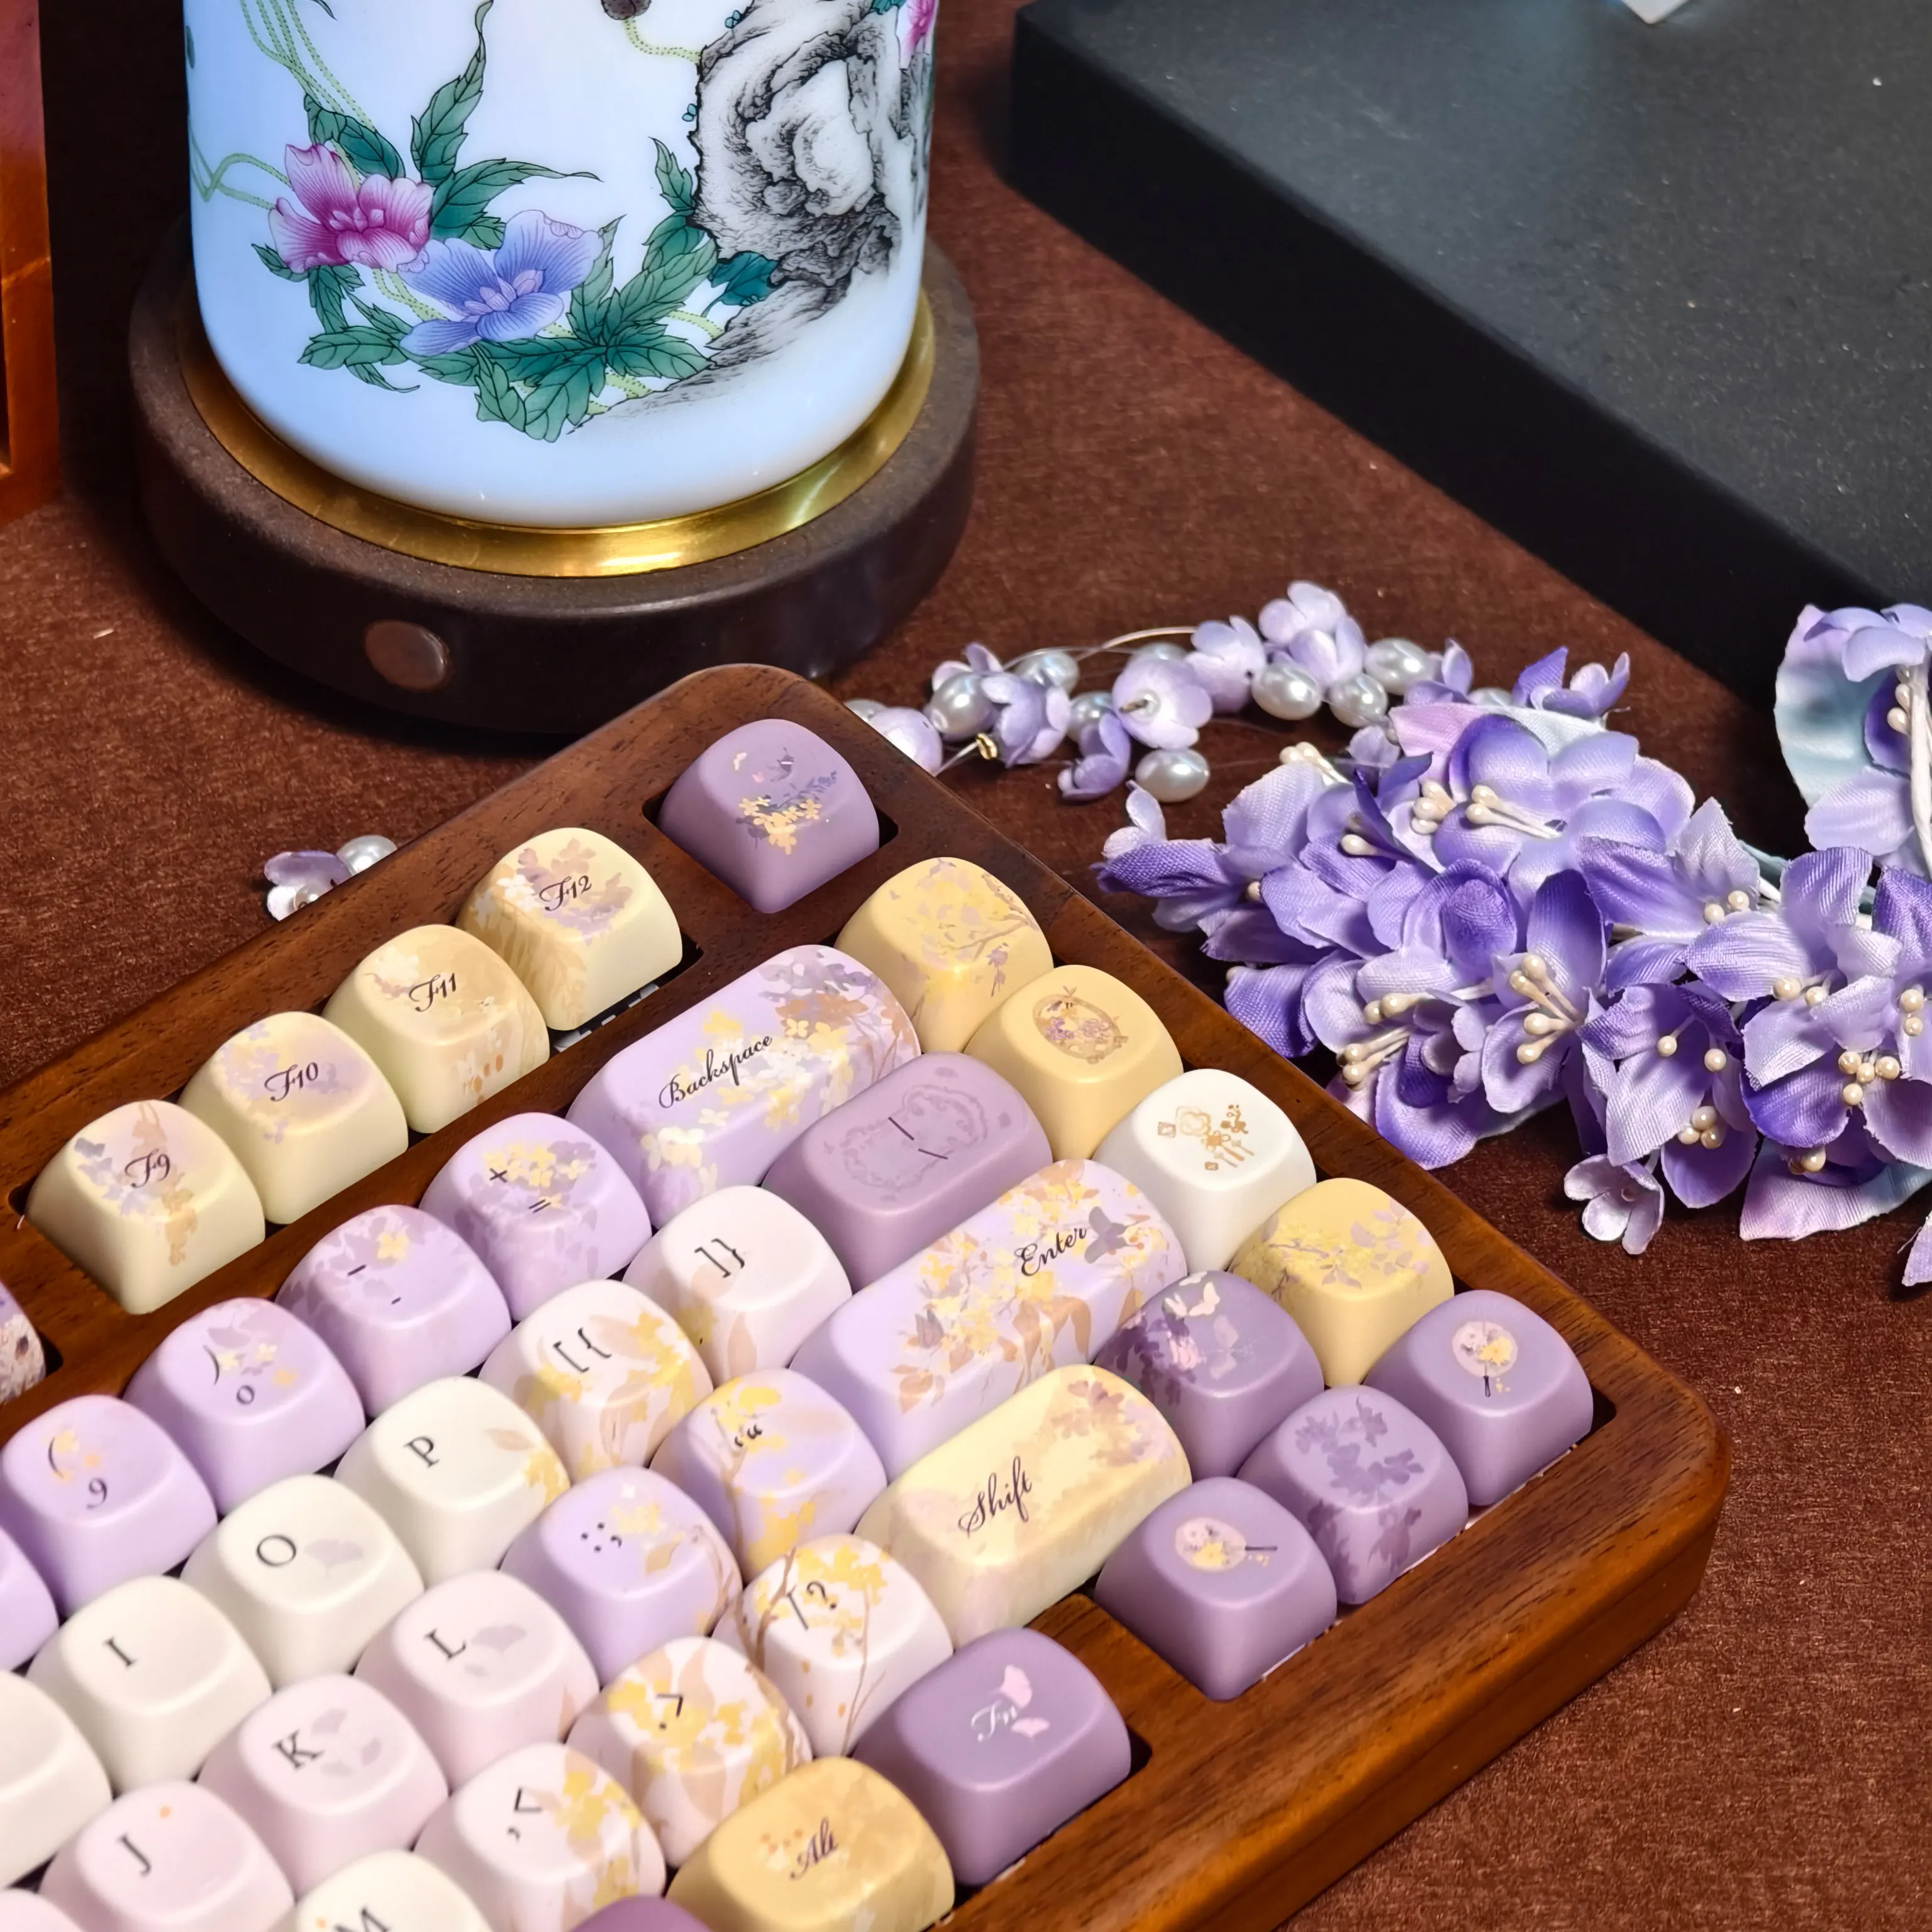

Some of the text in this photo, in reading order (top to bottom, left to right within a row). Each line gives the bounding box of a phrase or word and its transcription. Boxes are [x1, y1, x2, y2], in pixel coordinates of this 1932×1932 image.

[539, 875, 592, 911] F12
[409, 973, 457, 1012] F11
[265, 1062, 319, 1101] F10
[658, 1035, 772, 1109] Backspace
[125, 1150, 170, 1188] F9
[1014, 1226, 1087, 1277] Enter
[404, 1436, 439, 1468] P
[86, 1478, 107, 1509] 9
[958, 1456, 1033, 1538] Shift
[257, 1535, 296, 1567] O
[103, 1637, 136, 1668] I
[425, 1629, 467, 1660] L
[970, 1700, 1018, 1741] Fn
[273, 1730, 325, 1769] K
[118, 1834, 152, 1877] J
